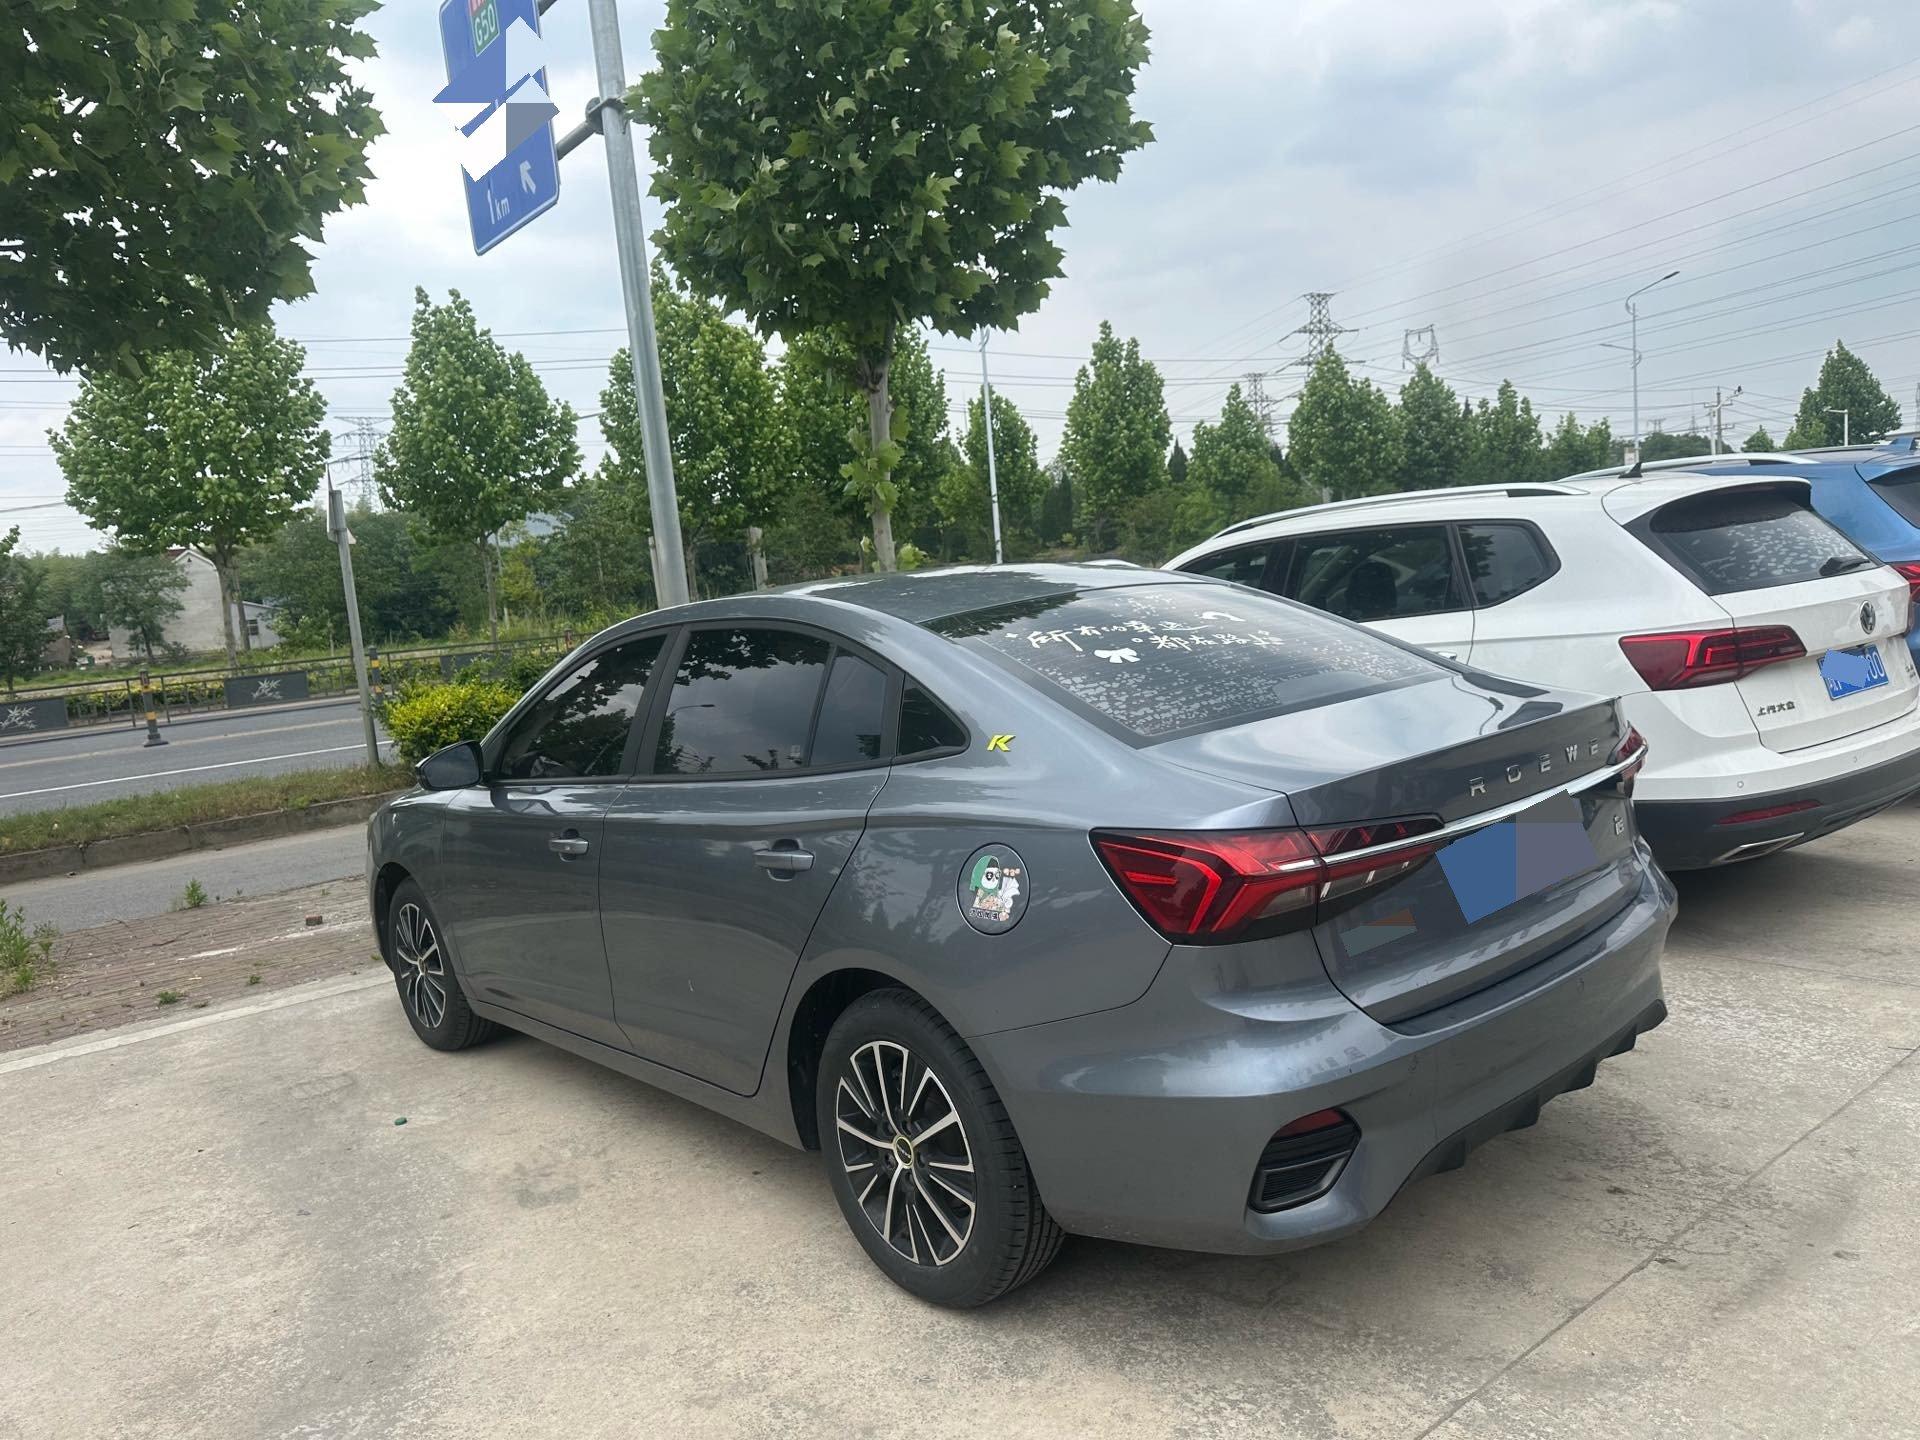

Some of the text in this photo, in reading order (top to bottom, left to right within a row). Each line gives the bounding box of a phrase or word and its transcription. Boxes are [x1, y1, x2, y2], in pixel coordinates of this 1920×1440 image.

[474, 4, 496, 46] G50
[1026, 619, 1212, 652] 所有的幸运
[1150, 631, 1284, 651] 都在路上
[1468, 737, 1600, 798] ROEWE
